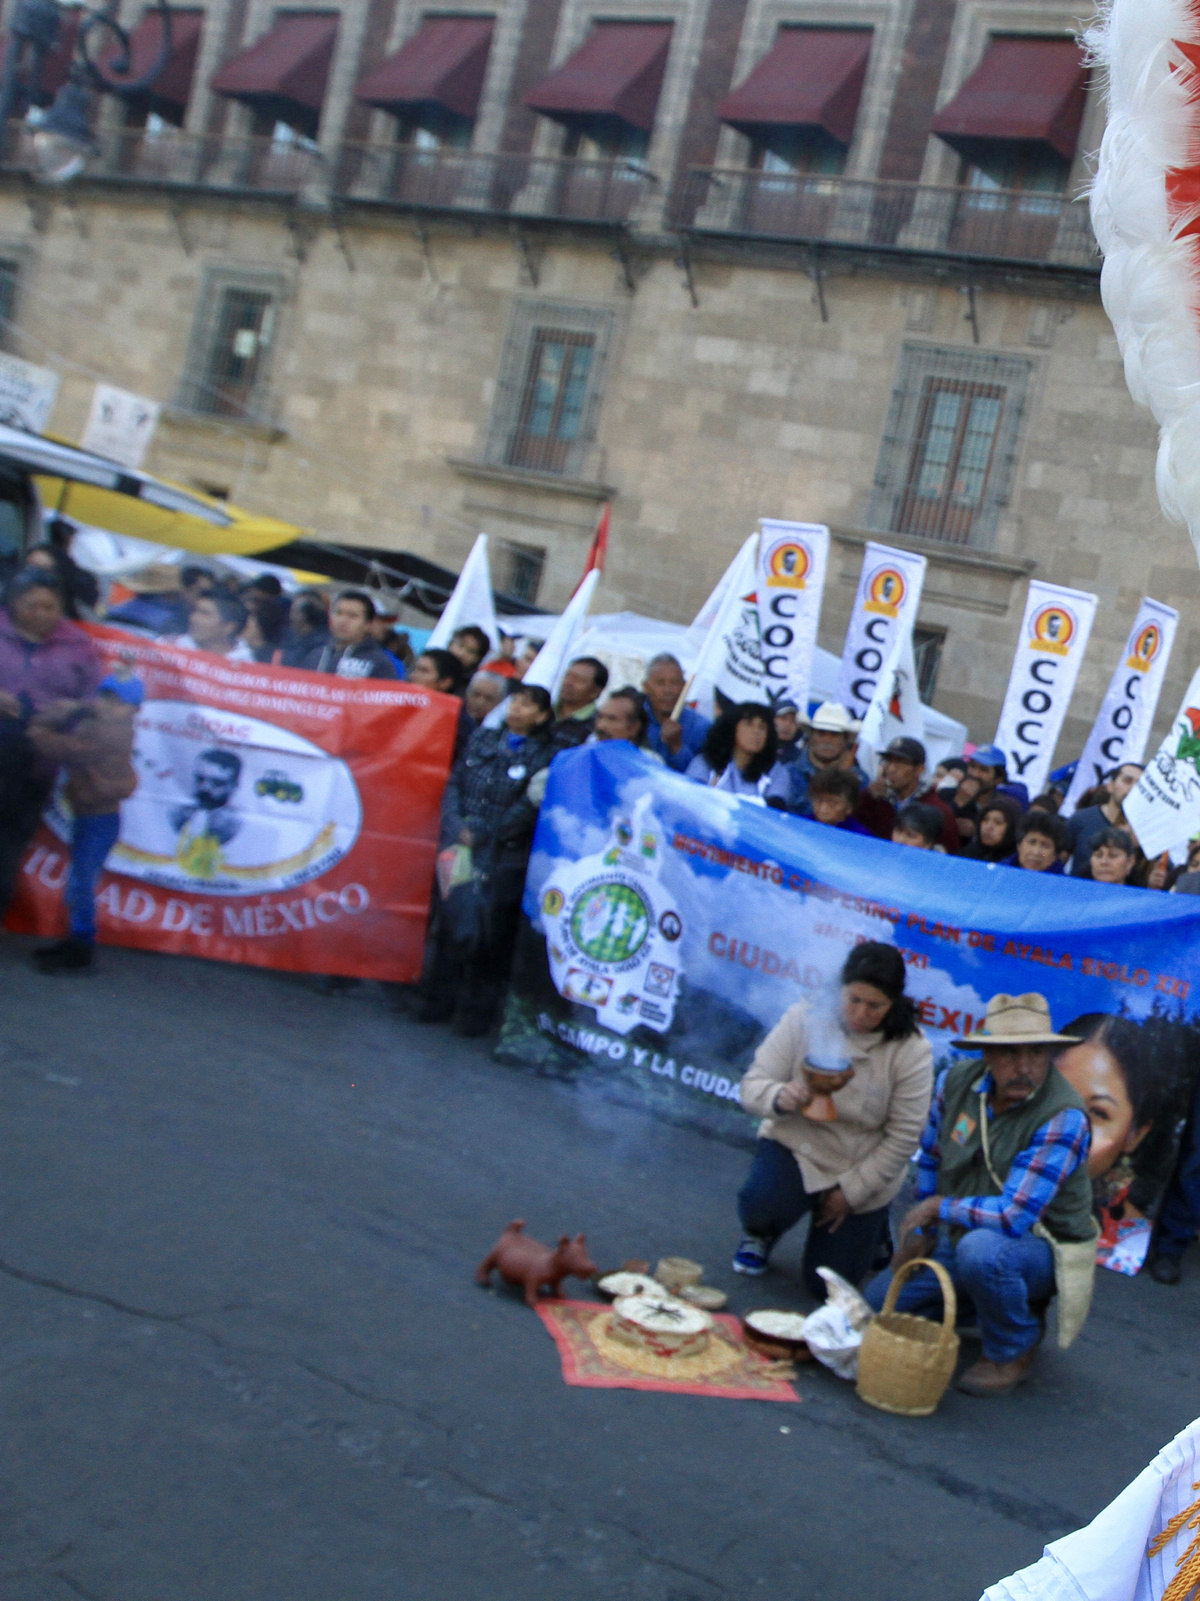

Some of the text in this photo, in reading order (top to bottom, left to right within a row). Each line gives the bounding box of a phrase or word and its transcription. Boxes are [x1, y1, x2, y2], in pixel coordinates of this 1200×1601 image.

[763, 593, 798, 702] COCY
[1012, 659, 1058, 776] COCY
[1093, 674, 1141, 785] COCY
[160, 897, 215, 937] DE
[223, 883, 369, 938] MÉXICO
[672, 832, 784, 886] MOVIMIENTO
[789, 873, 900, 924] CAMPESINO
[907, 913, 961, 943] PLAN
[968, 930, 996, 952] DE
[1003, 941, 1073, 971] AYALA
[1080, 957, 1149, 987] SIGLO
[1154, 974, 1191, 1000] XXI
[557, 1021, 627, 1061] CAMPO
[632, 1046, 649, 1067] Y
[651, 1053, 676, 1080] LA
[680, 1064, 741, 1104] CIUDA
